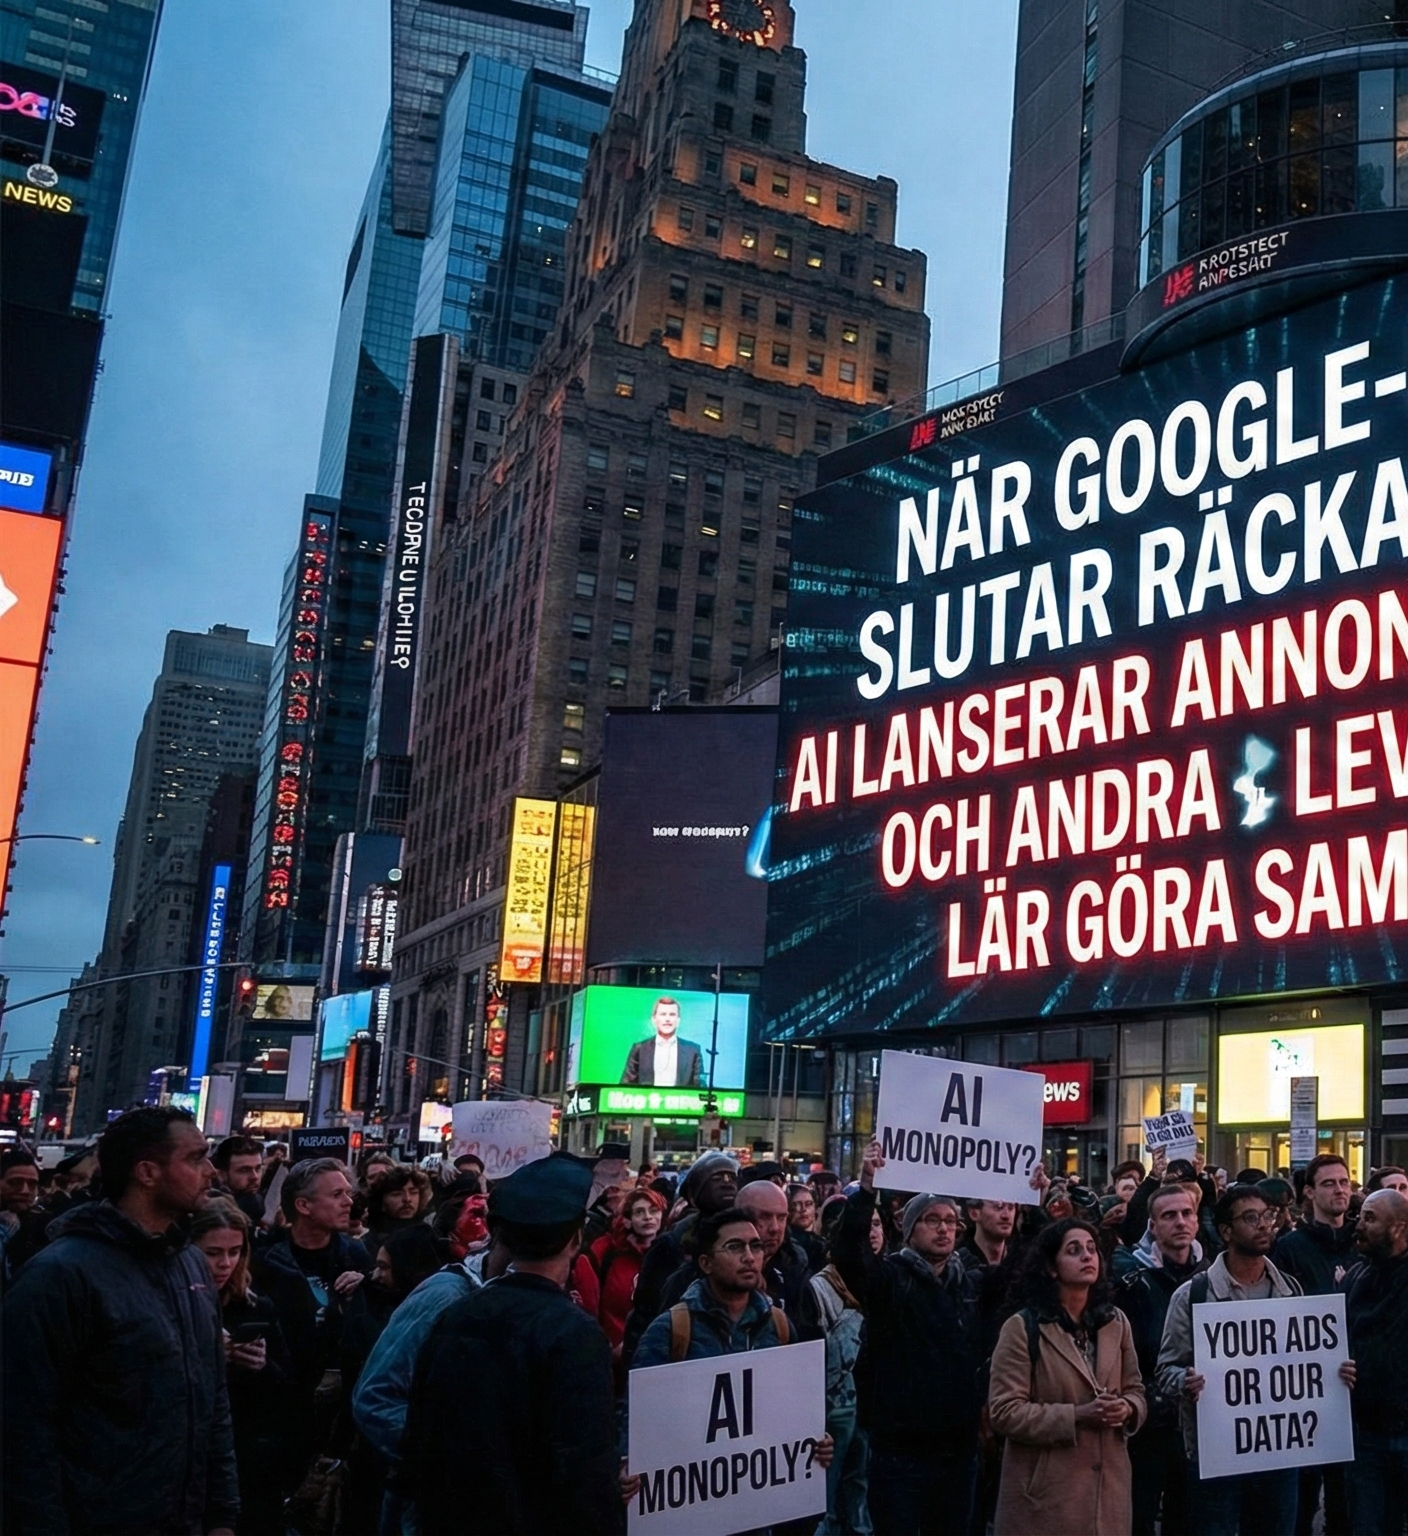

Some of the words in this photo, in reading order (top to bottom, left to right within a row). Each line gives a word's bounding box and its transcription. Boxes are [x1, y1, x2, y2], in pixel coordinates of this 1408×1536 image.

[4, 181, 73, 213] NEWS
[895, 453, 1032, 584] NÄR
[856, 549, 1112, 700] SLUTAR
[789, 730, 839, 812] AI
[852, 654, 1151, 798] LANSERAR
[881, 794, 990, 888] OCH
[1005, 749, 1221, 867] ANDRA
[946, 867, 1050, 978] LÄR
[1066, 854, 1238, 963] GÖRA
[940, 1072, 983, 1127] AI
[882, 1126, 1037, 1176] MONOPOLY?
[1203, 1318, 1277, 1359] YOUR
[1285, 1313, 1339, 1353] ADS
[705, 1368, 753, 1444] AI
[1224, 1368, 1261, 1407] OR
[1269, 1362, 1324, 1403] OUR
[1234, 1410, 1318, 1455] DATA?
[638, 1437, 818, 1516] MONOPOLY?
